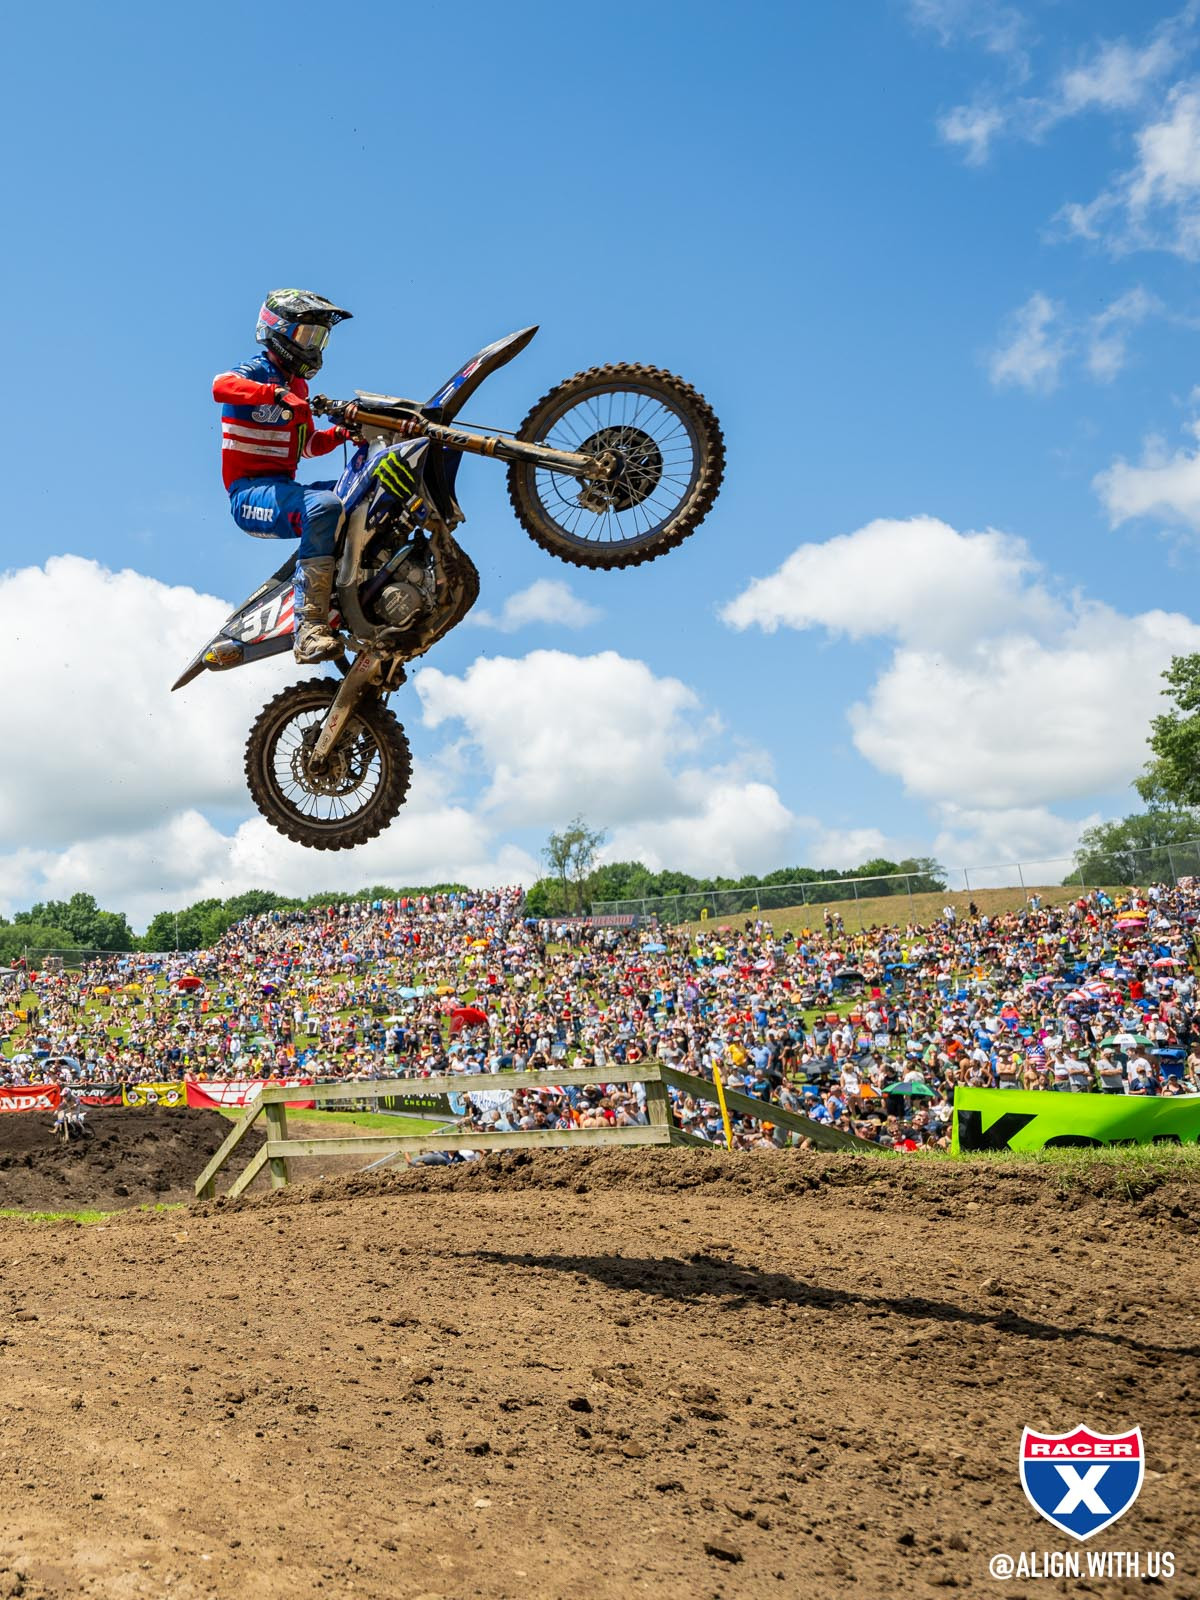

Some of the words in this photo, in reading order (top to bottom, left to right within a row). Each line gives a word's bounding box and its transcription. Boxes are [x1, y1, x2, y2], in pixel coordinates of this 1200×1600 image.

[242, 505, 273, 522] THOR
[241, 595, 282, 643] 37
[71, 1089, 106, 1097] MX-ATV
